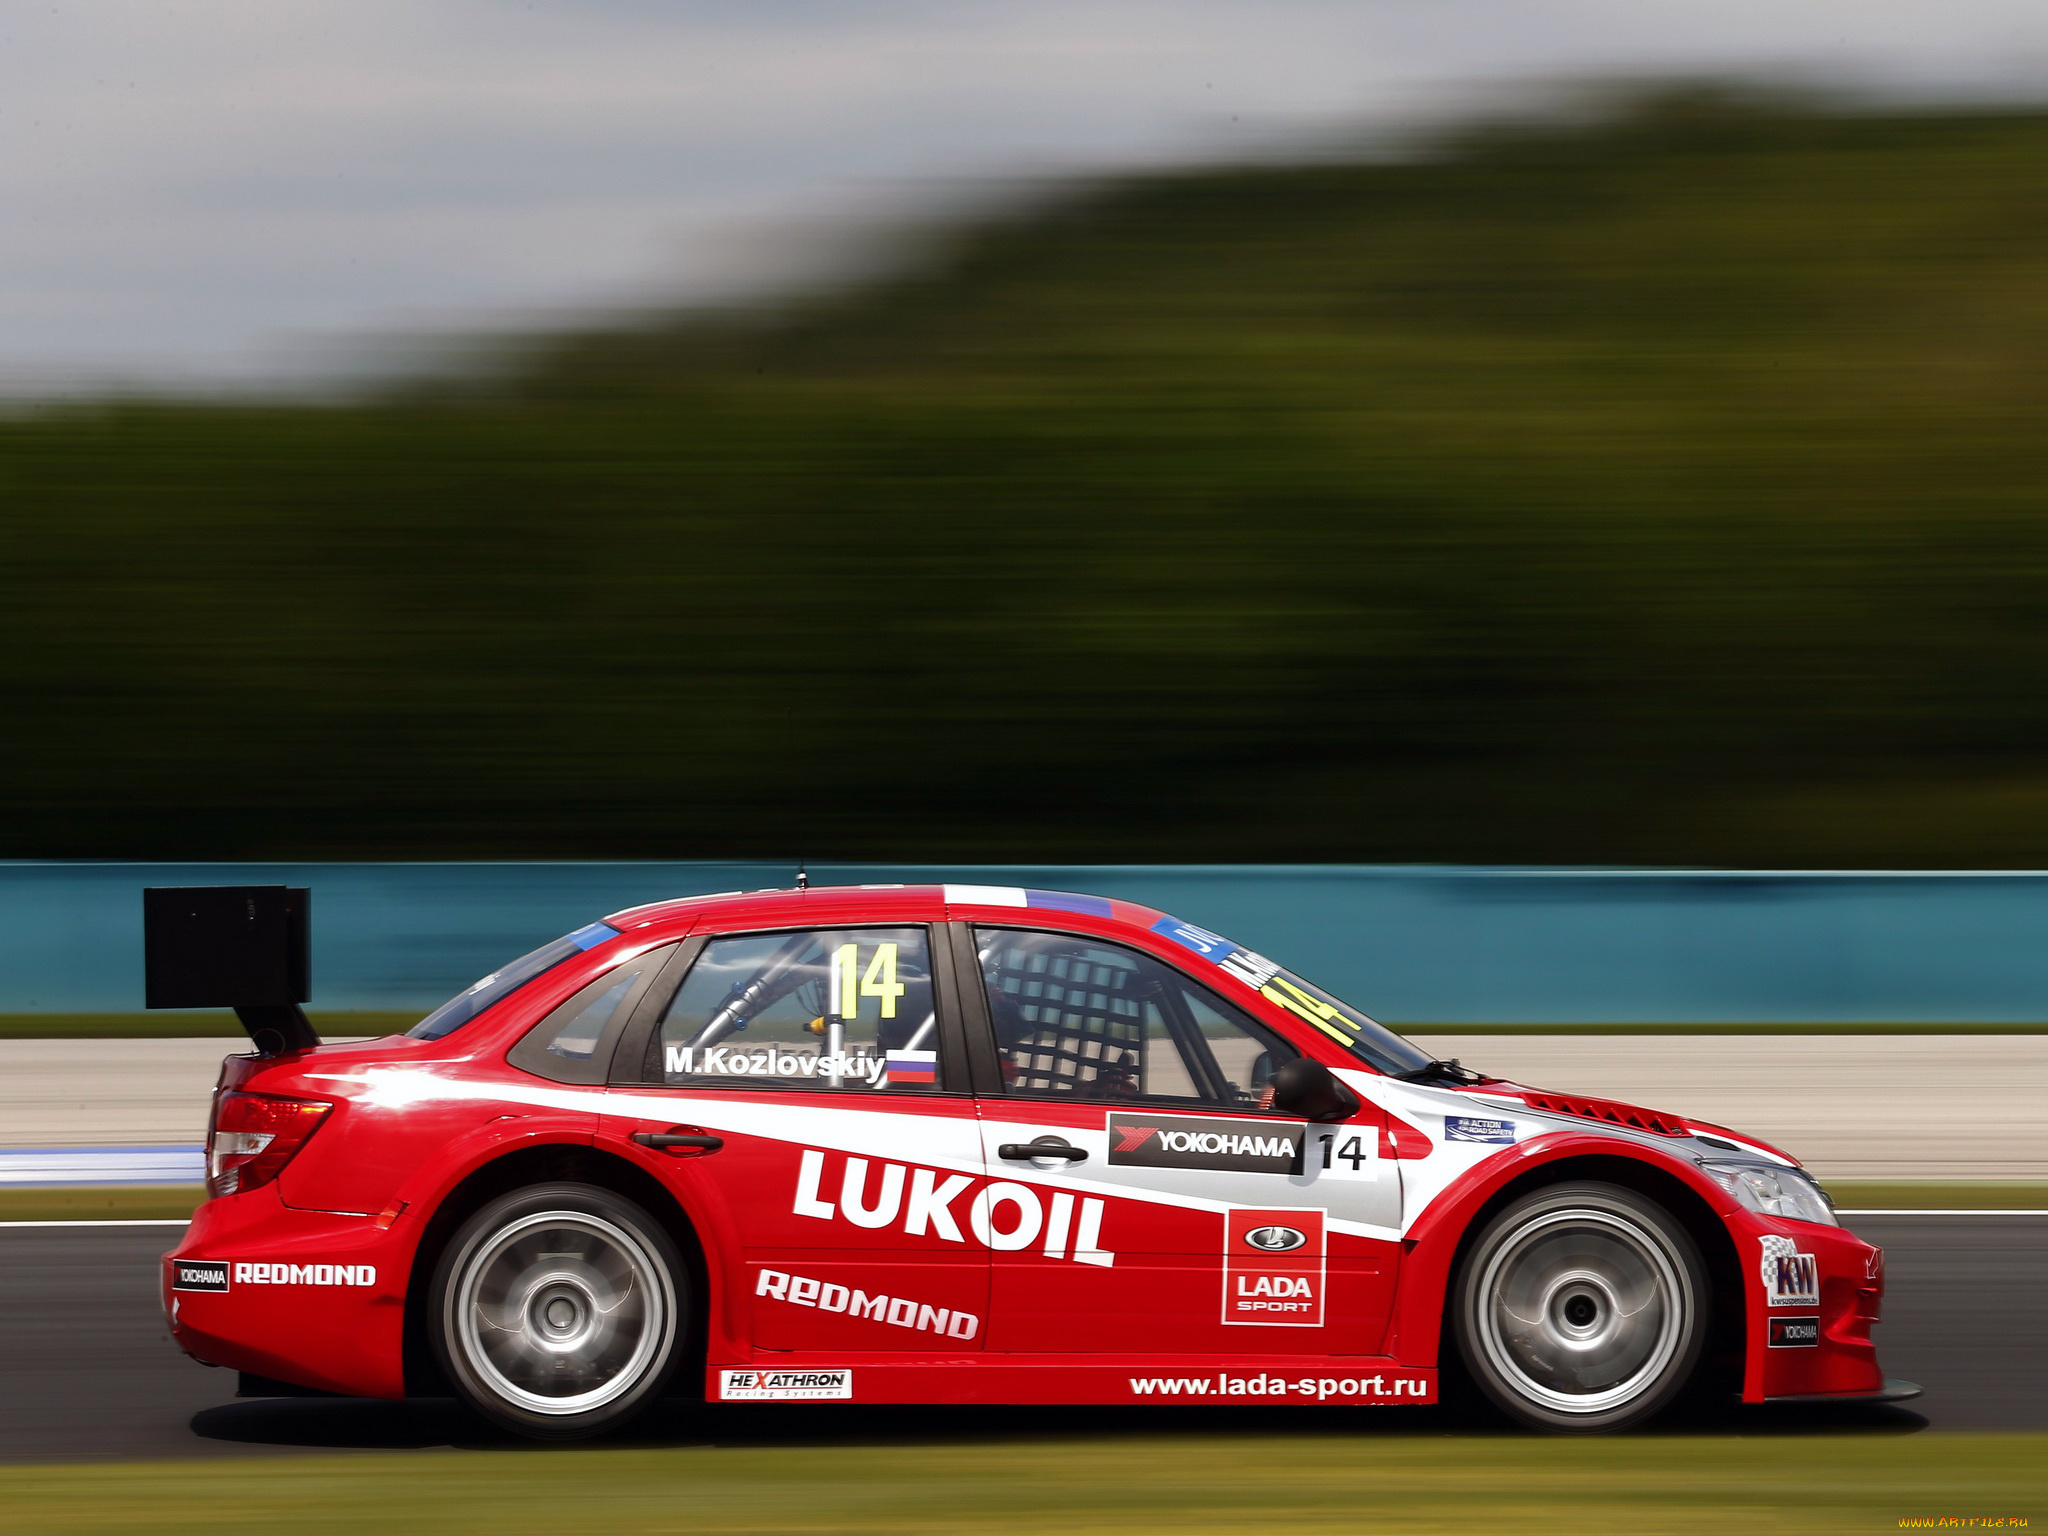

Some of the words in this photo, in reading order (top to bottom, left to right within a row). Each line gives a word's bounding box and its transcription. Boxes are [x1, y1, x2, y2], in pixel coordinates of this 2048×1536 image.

[831, 943, 905, 1020] 14
[1259, 976, 1362, 1047] 14
[665, 1046, 886, 1084] M.Kozlovskiy
[1471, 1120, 1502, 1129] ACTION
[1157, 1130, 1296, 1158] YOKOHAMA
[1318, 1133, 1367, 1171] 14
[793, 1149, 1116, 1268] LUKOIL
[180, 1268, 226, 1285] YOKOHAMA
[1237, 1275, 1313, 1298] LADA
[1777, 1256, 1816, 1296] KW
[1236, 1301, 1313, 1312] SPORT
[1785, 1325, 1818, 1339] YOKOHAMA
[726, 1390, 775, 1398] Racing
[784, 1390, 842, 1398] Systems
[729, 1372, 846, 1389] HEXATHRON
[1129, 1373, 1428, 1400] www.lada-sport.ru
